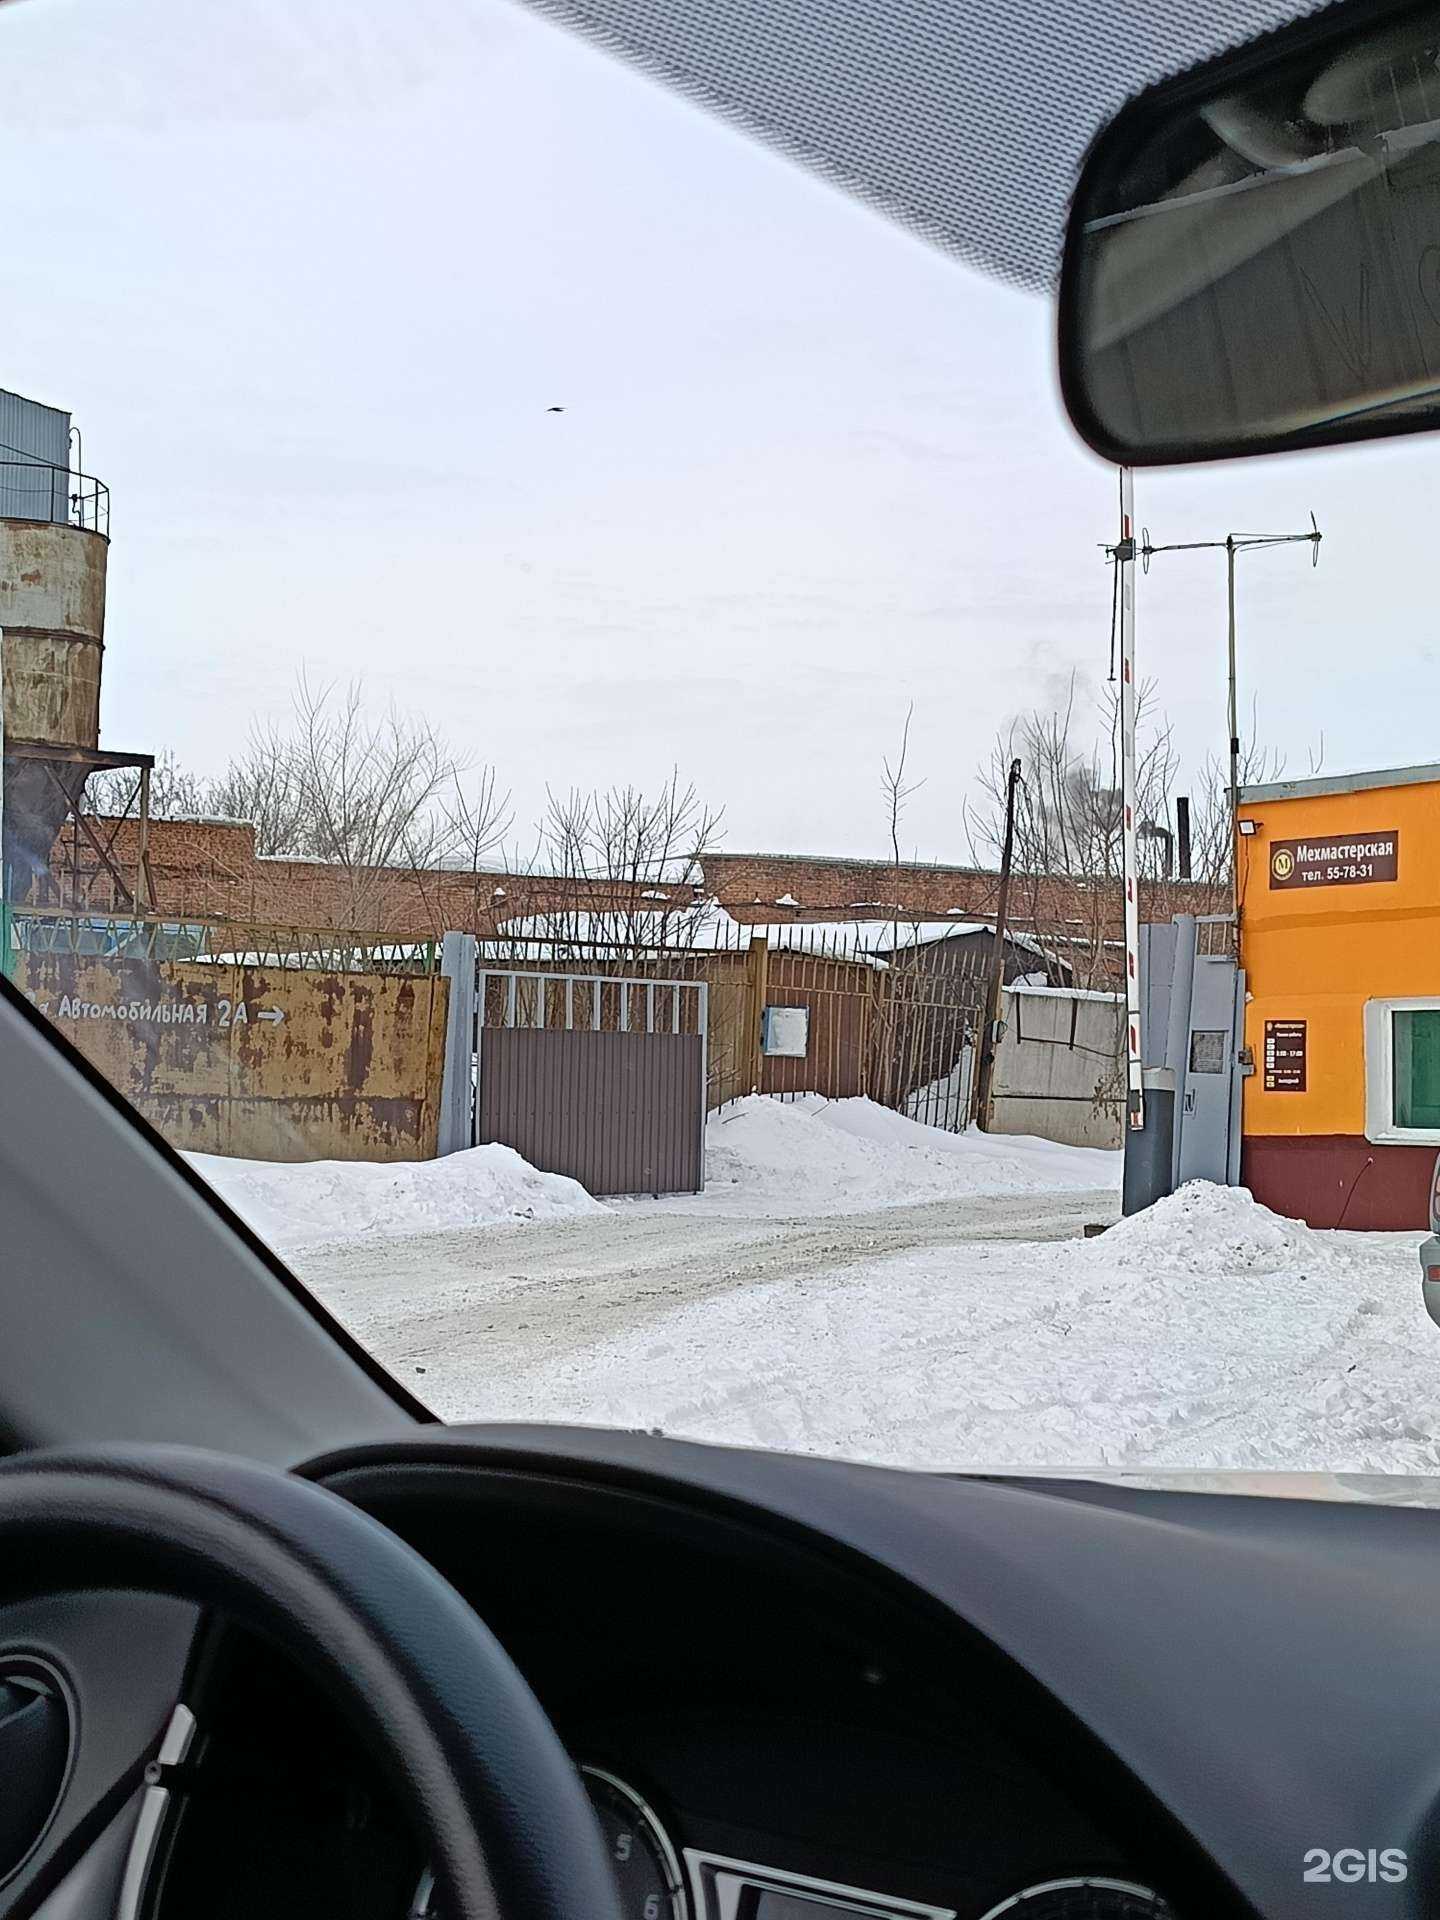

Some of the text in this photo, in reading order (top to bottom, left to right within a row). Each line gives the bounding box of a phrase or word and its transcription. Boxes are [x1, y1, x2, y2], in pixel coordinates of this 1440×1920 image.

[1297, 842, 1393, 864] Мехмастерская
[1302, 863, 1373, 882] тел. 55-78-31
[616, 1833, 632, 1861] 5
